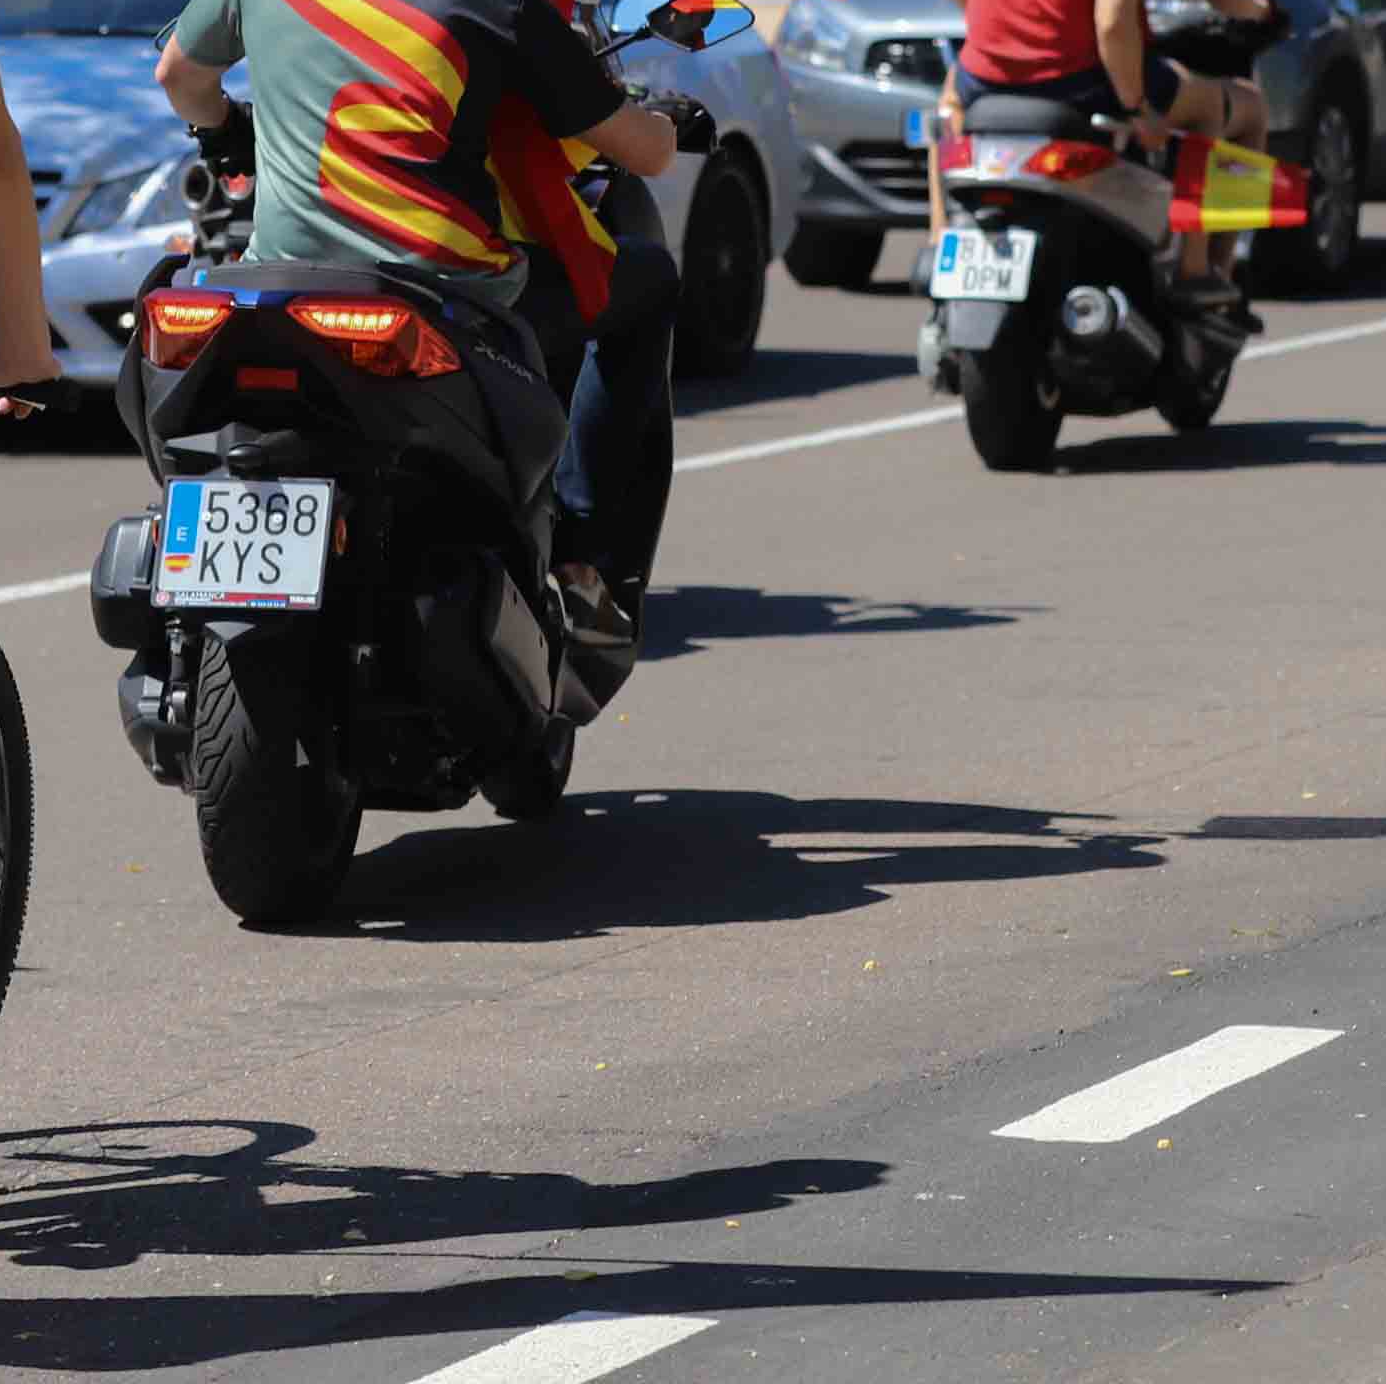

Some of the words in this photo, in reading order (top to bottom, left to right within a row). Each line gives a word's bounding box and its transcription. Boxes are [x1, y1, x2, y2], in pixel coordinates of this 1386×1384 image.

[175, 526, 188, 542] E
[205, 490, 319, 536] 5368
[198, 540, 284, 585] KYS
